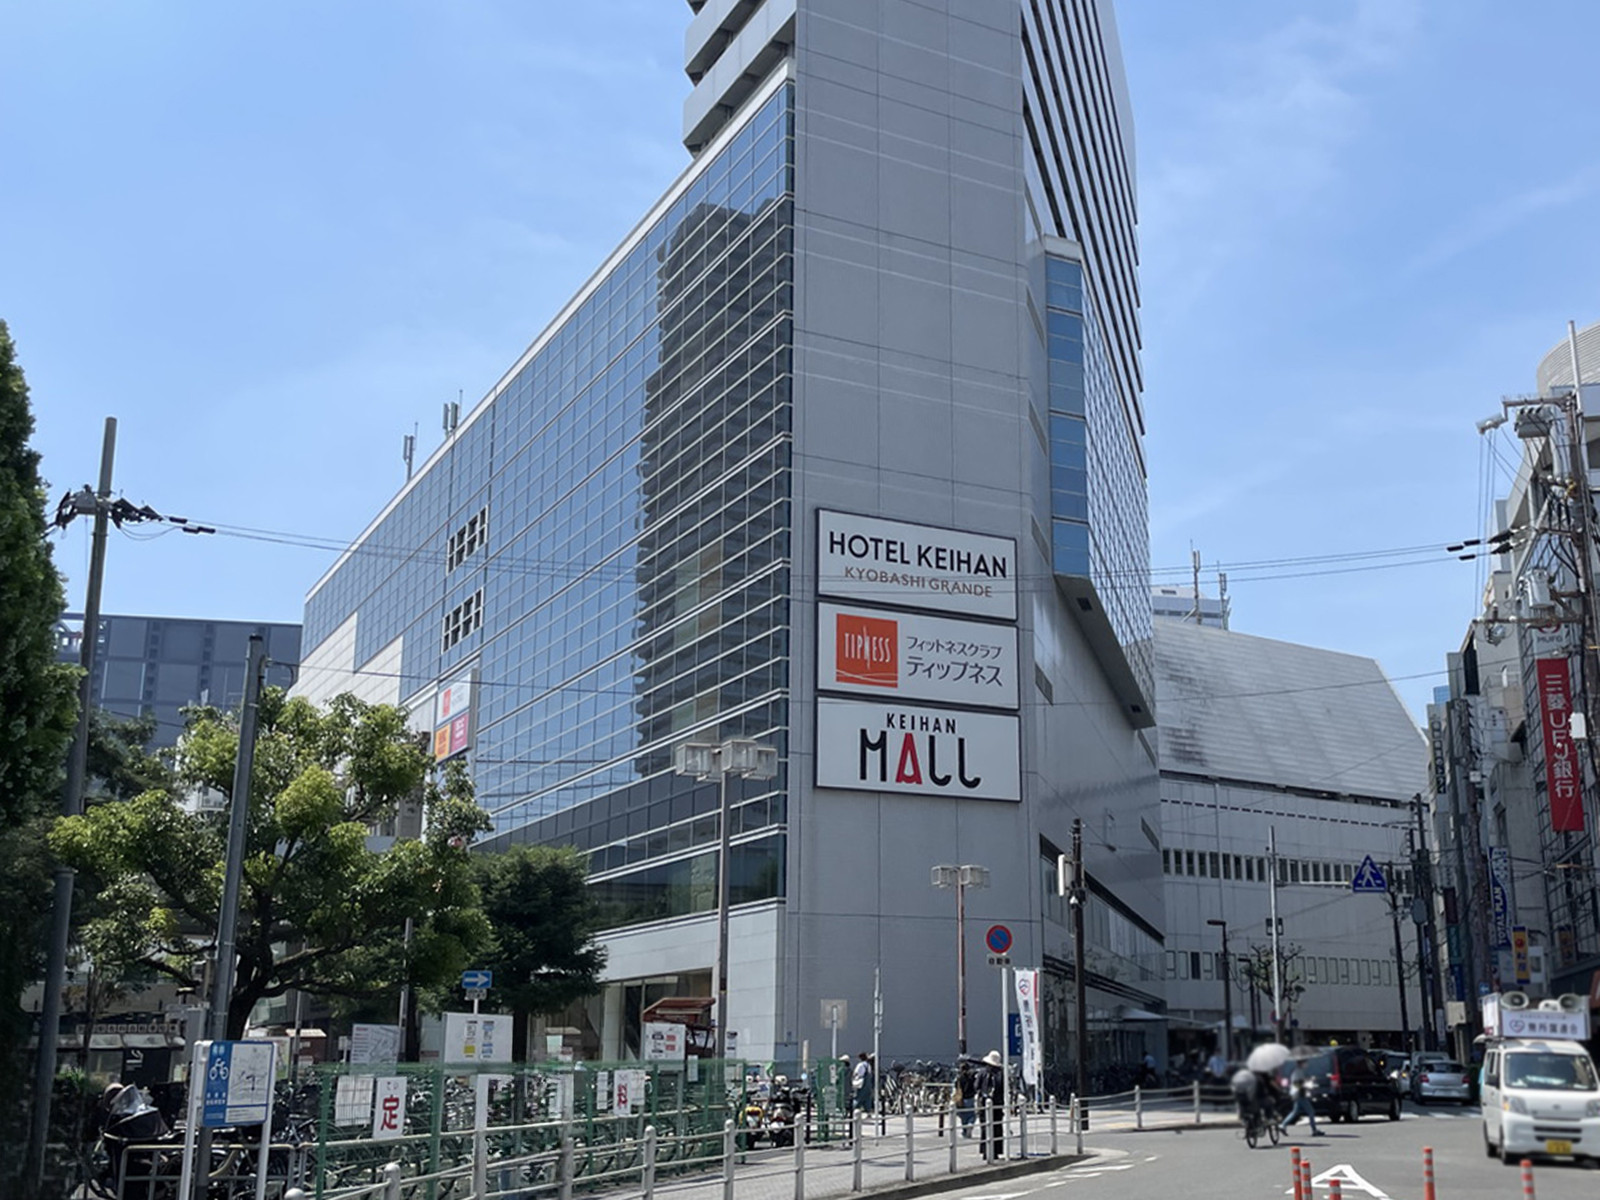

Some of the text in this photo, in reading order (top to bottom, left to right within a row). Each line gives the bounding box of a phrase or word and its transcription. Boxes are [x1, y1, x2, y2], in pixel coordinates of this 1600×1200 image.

[829, 530, 1007, 579] HOTEL KEIHAN
[844, 566, 993, 598] KYOBASHI GRANDE
[906, 636, 1003, 660] フィットネスクラブ
[906, 656, 1003, 687] ティップネス
[886, 712, 957, 735] KEIHAN
[1545, 674, 1575, 799] 三菱UFJ銀行
[859, 728, 981, 789] MALL
